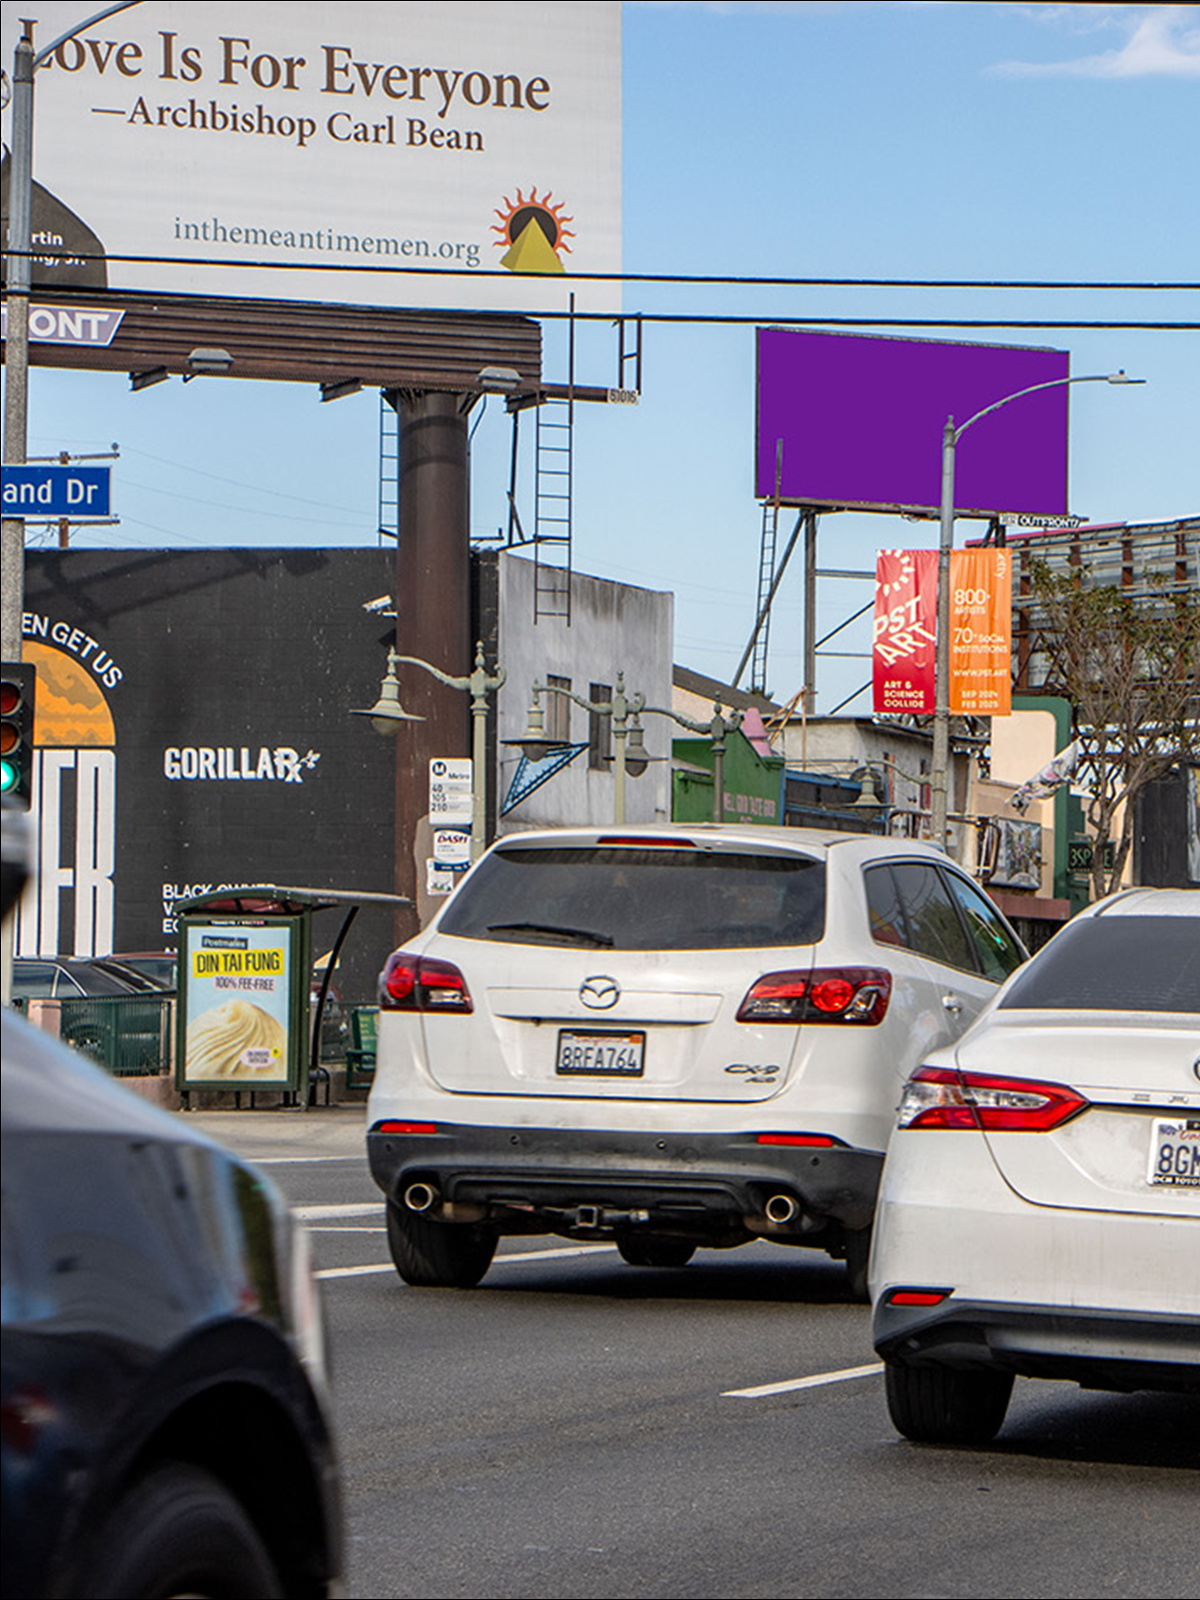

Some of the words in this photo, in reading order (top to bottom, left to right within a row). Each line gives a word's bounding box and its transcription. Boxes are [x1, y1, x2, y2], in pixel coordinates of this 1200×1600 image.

[158, 31, 203, 82] Is
[218, 36, 306, 92] For
[319, 45, 551, 118] Everyone
[327, 111, 395, 145] Carl
[406, 119, 485, 152] Bean
[29, 230, 64, 246] rtin
[174, 217, 481, 267] inthemeantimemen.org
[28, 308, 110, 341] ONT
[66, 479, 98, 504] Dr
[873, 595, 921, 643] PST
[875, 621, 936, 665] ART
[51, 621, 99, 658] GET
[92, 650, 123, 689] US
[884, 681, 902, 689] ART
[884, 690, 925, 699] SCIENCE
[884, 699, 925, 709] COLLIDE
[432, 784, 443, 793] 40
[432, 794, 446, 802] 105
[431, 803, 448, 812] 210
[437, 835, 468, 845] DASH
[162, 884, 212, 899] BLACK
[203, 938, 246, 948] Postmates
[197, 954, 219, 973] DIN
[221, 953, 242, 972] TAI
[245, 951, 280, 971] FUNG
[215, 976, 237, 988] 100%
[238, 977, 274, 991] FEE-FREE
[562, 1047, 637, 1069] 8RFA764
